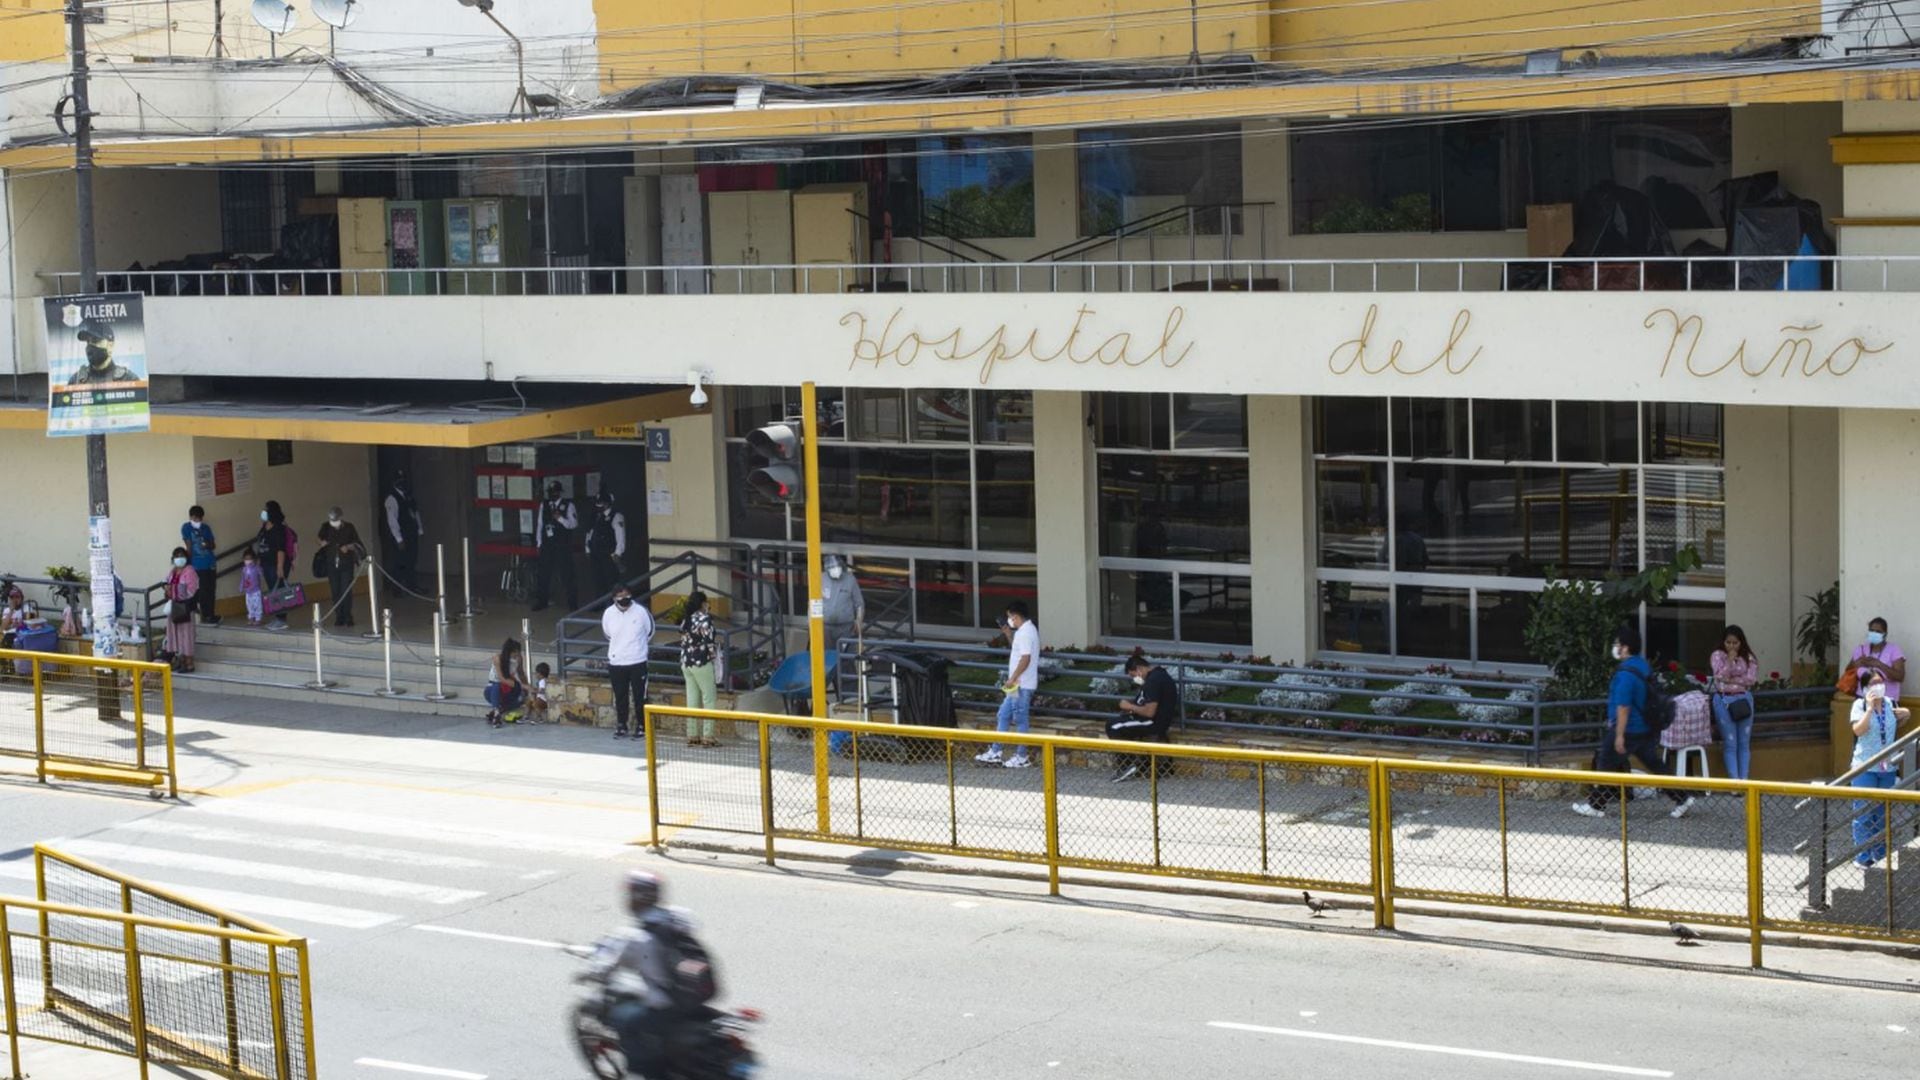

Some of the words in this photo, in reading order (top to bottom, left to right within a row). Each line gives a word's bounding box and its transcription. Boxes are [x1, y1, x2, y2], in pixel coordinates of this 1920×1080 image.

[84, 303, 127, 318] ALERTA
[839, 302, 1196, 385] Hospital
[1328, 303, 1485, 376] del
[1643, 308, 1895, 379] Niño
[656, 432, 664, 448] 3
